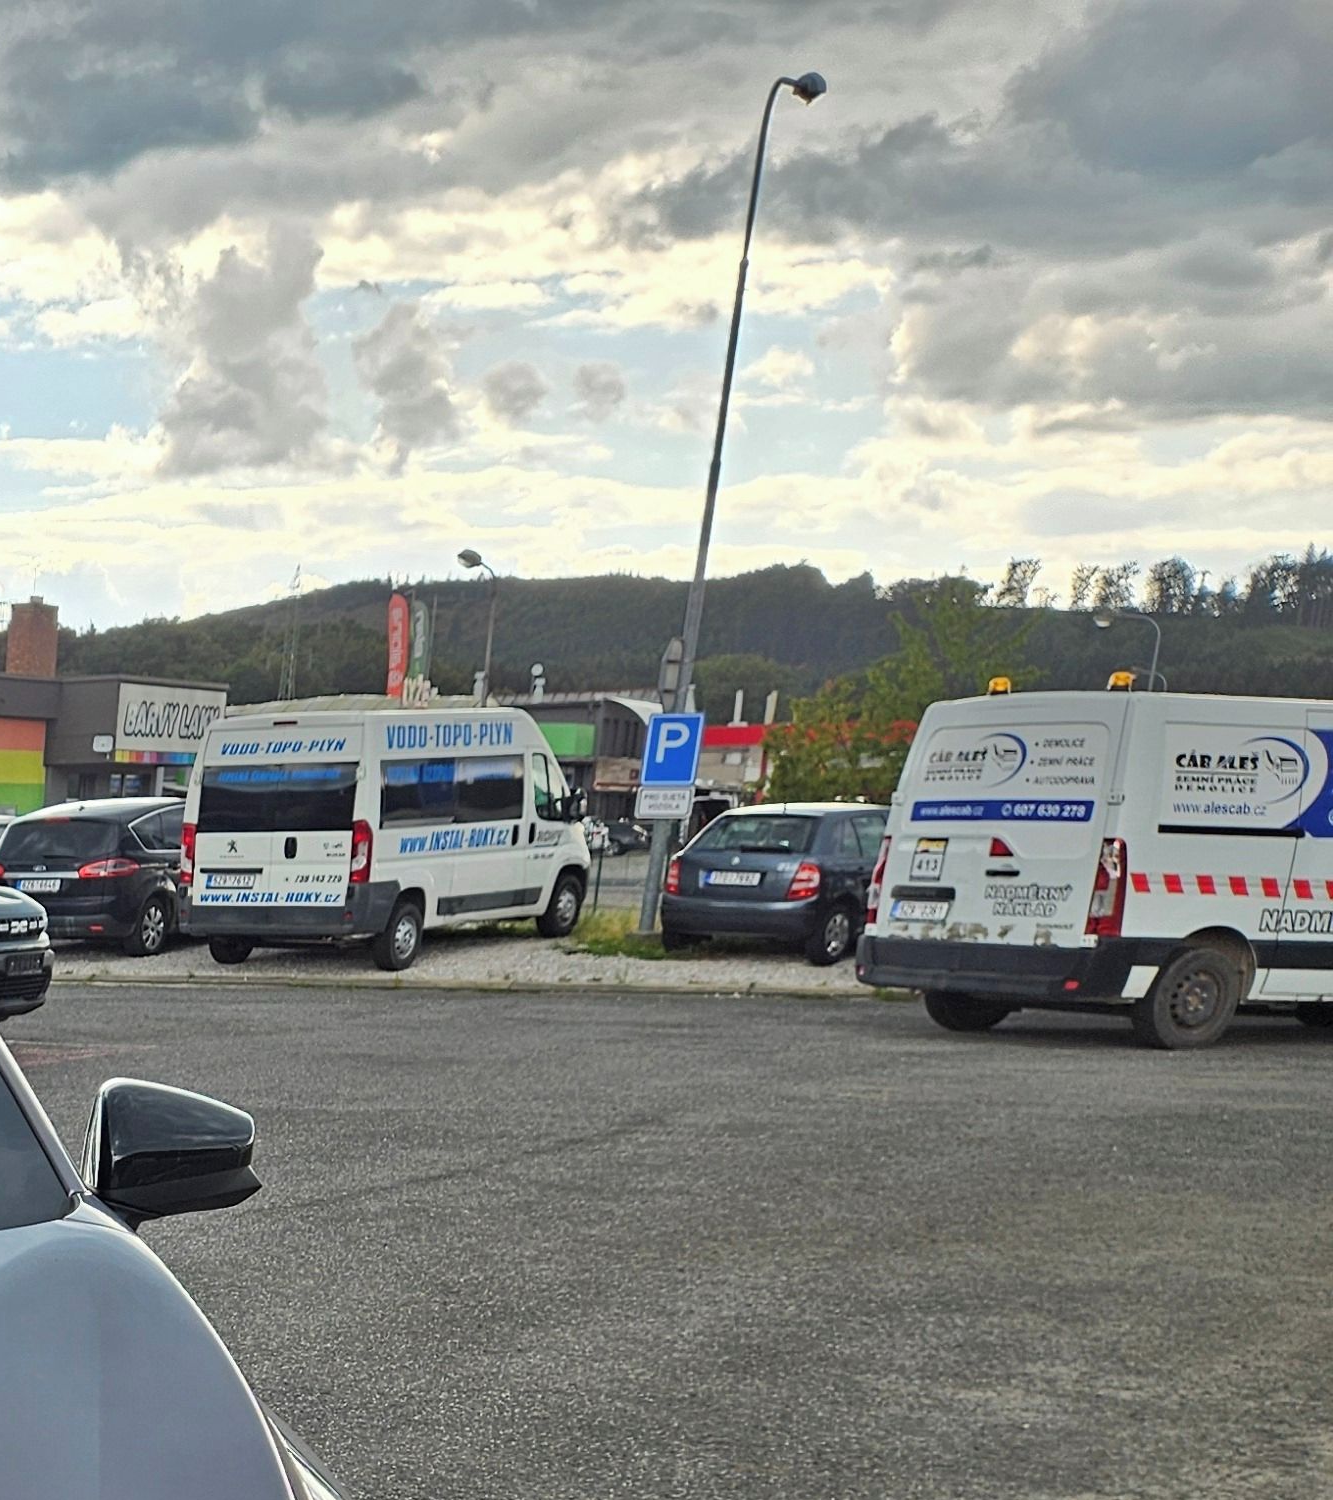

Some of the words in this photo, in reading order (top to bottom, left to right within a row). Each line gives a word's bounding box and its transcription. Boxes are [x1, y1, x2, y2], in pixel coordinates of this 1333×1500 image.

[124, 700, 180, 738] BARVY
[655, 722, 690, 763] P
[1175, 749, 1212, 769] CÁB
[1215, 752, 1259, 771] ALEŠ
[1174, 784, 1258, 794] DEMOLICE
[1217, 774, 1259, 786] PRÁCE
[1014, 803, 1035, 818] 607
[1037, 804, 1060, 818] 630
[1173, 802, 1267, 817] www.alescab.cz
[985, 883, 1074, 902] NADMĚRNÝ
[993, 899, 1058, 918] NÁKLAD
[1258, 908, 1333, 933] NADM
